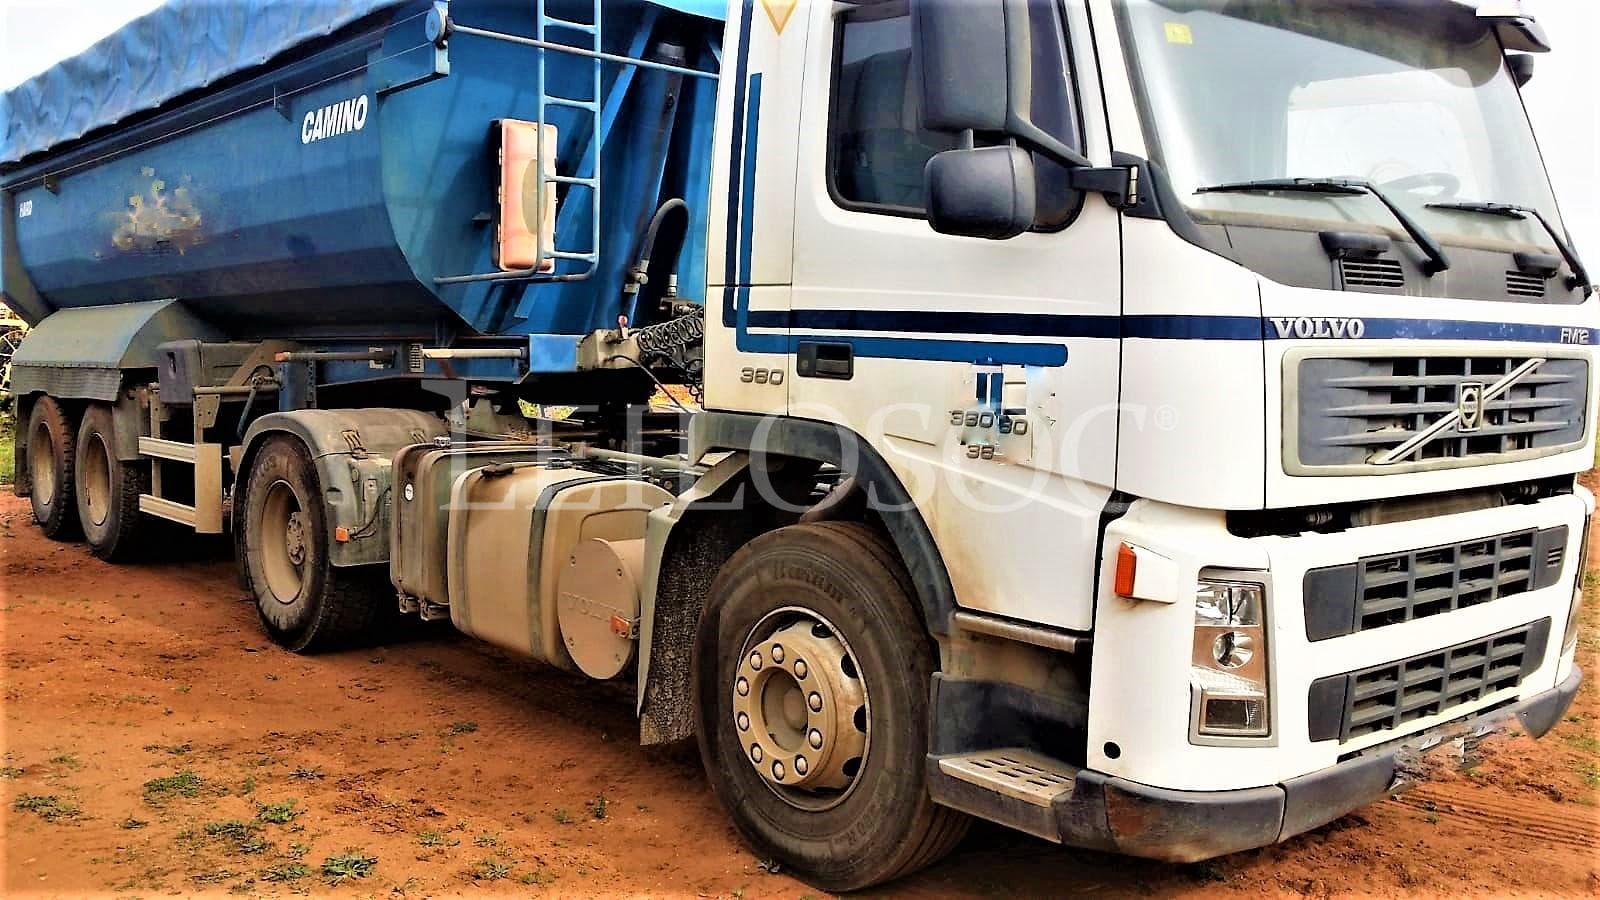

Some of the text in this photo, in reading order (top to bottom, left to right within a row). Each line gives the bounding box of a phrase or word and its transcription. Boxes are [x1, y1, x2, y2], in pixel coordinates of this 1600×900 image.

[301, 94, 369, 145] CAMINO
[1269, 316, 1365, 339] VOLVO
[740, 366, 785, 386] 380
